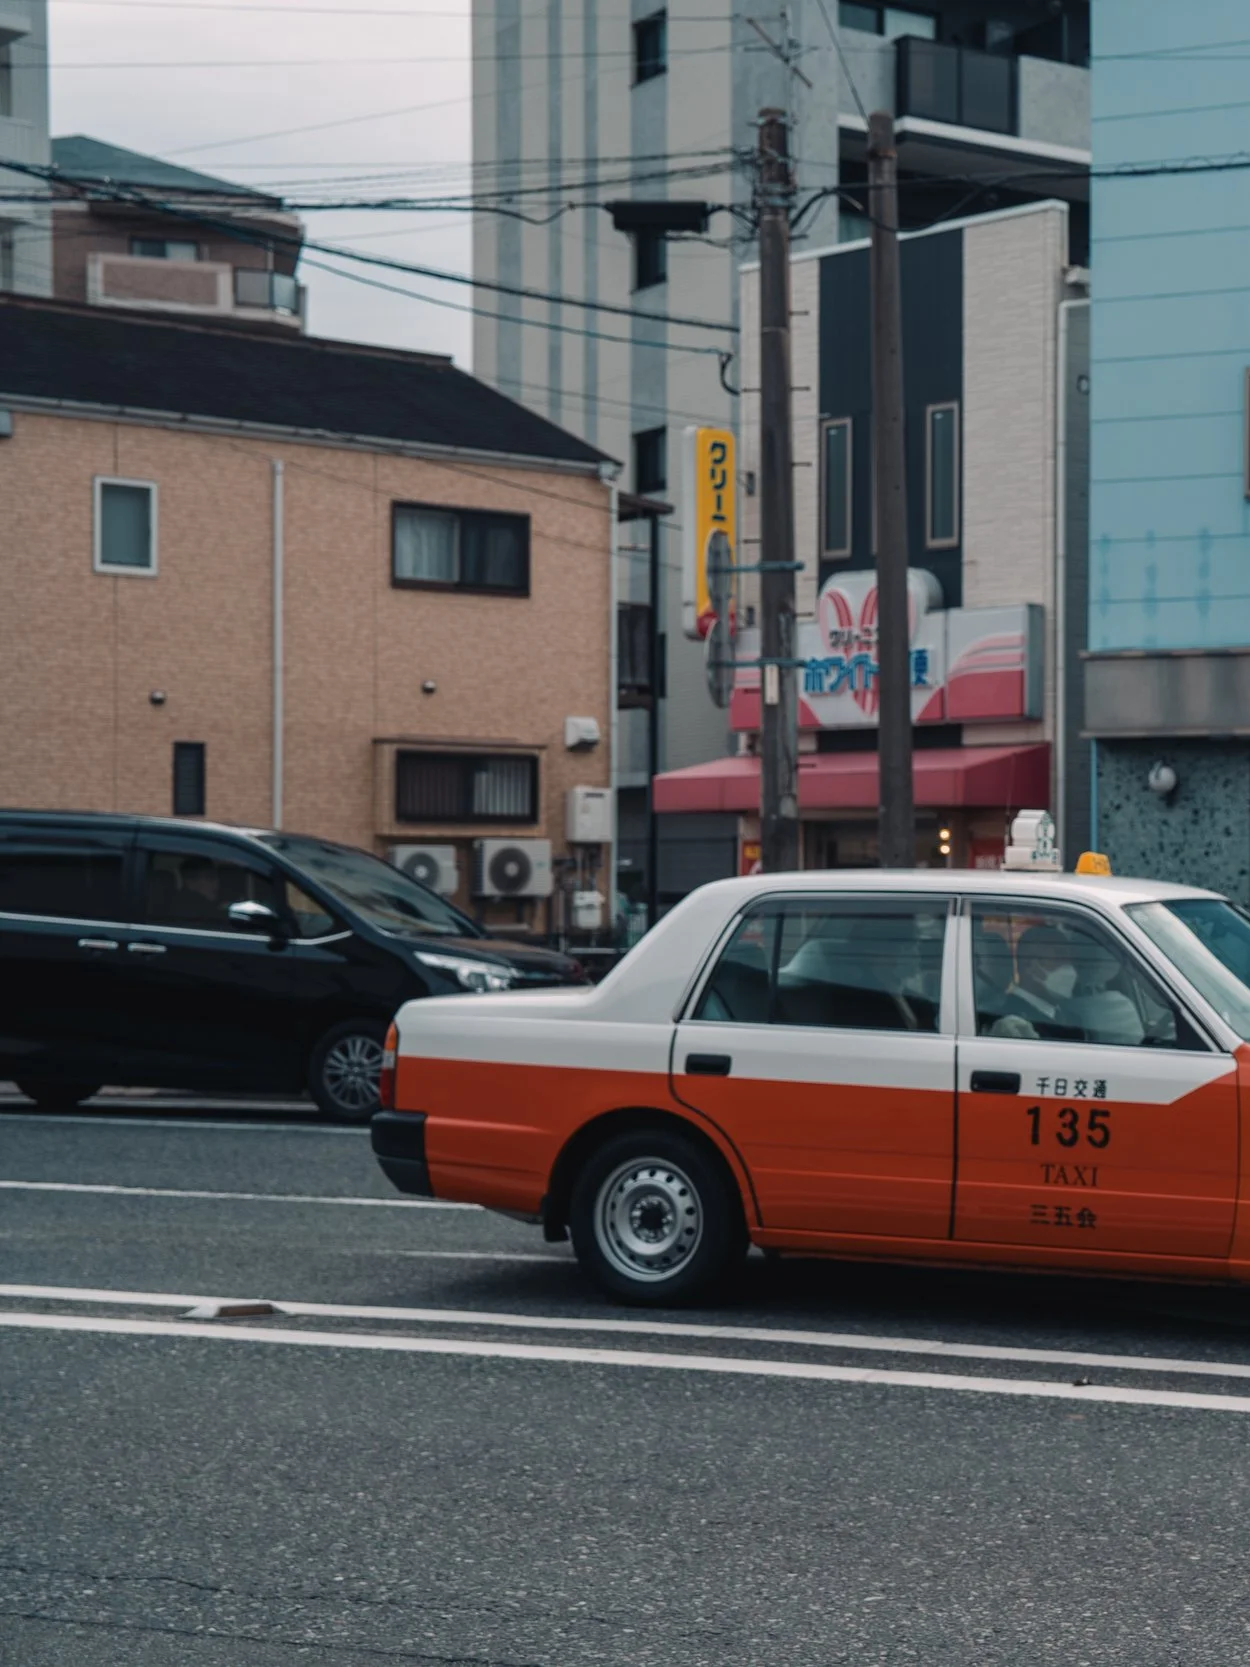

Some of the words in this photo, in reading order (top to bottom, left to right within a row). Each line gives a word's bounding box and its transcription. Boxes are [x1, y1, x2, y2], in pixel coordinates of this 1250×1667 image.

[804, 648, 928, 693] ホワイト便
[1036, 1076, 1107, 1099] 千日交通
[1027, 1106, 1111, 1149] 135
[1040, 1163, 1099, 1187] TAXI
